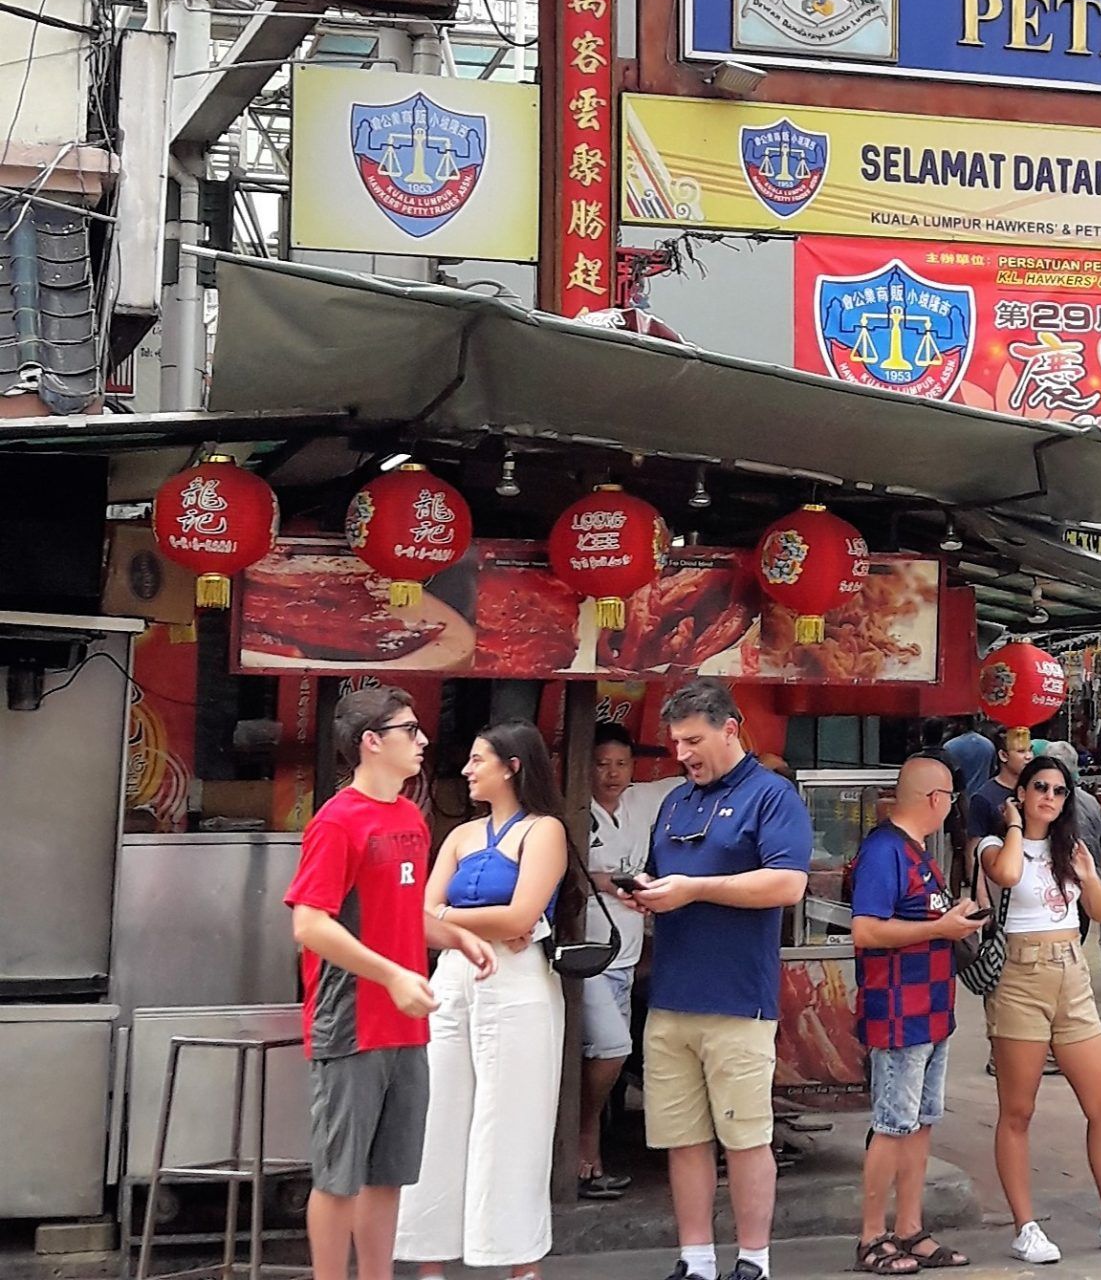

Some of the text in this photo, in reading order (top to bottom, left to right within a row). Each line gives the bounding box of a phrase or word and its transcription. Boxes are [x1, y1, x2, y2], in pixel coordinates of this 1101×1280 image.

[861, 144, 1006, 188] SELAMAT
[871, 212, 919, 226] KUALA
[923, 216, 982, 231] LUMPUR
[1061, 224, 1071, 235] &
[998, 256, 1080, 271] PERSATUAN
[997, 272, 1025, 285] K.L.
[885, 369, 913, 382] 1953
[176, 475, 228, 534] 龍記
[409, 489, 456, 545] 龍記
[400, 860, 416, 886] R
